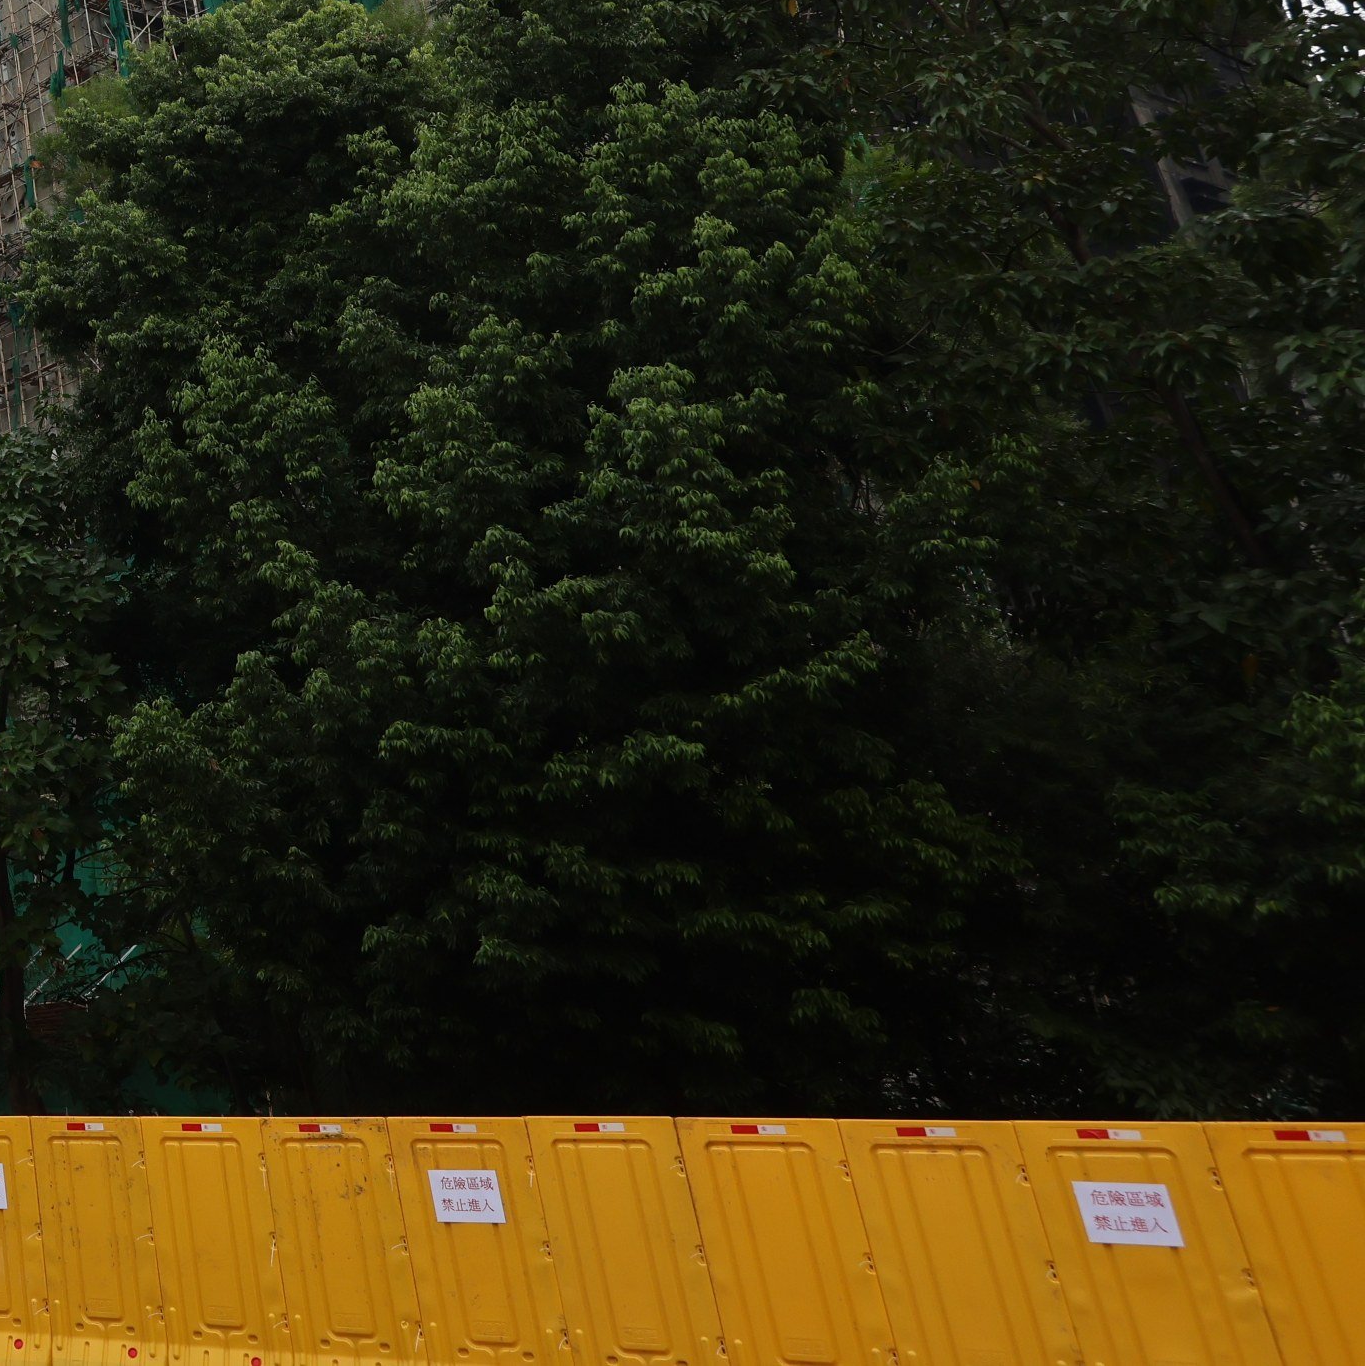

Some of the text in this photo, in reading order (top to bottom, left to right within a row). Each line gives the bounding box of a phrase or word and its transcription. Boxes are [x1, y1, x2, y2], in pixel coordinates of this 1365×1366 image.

[441, 1176, 494, 1191] 危險區域
[1090, 1189, 1165, 1209] 危險區域
